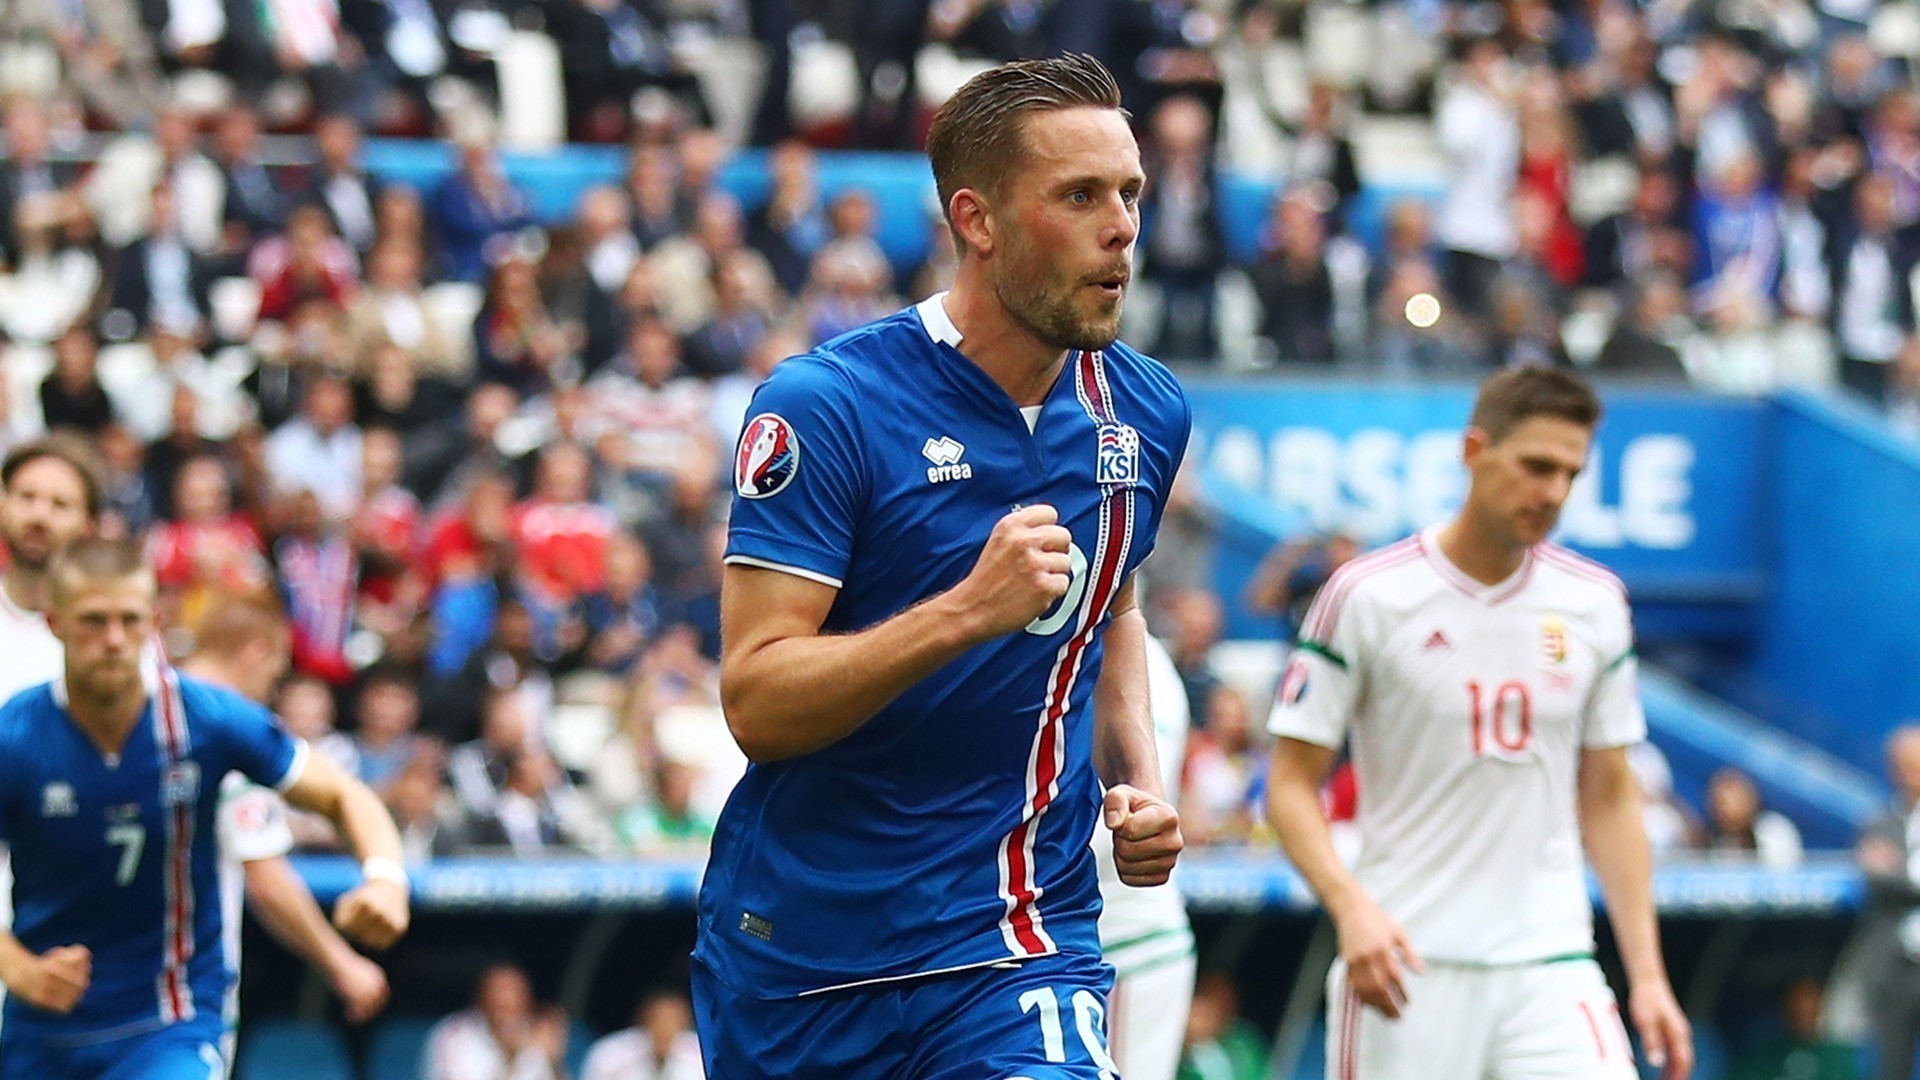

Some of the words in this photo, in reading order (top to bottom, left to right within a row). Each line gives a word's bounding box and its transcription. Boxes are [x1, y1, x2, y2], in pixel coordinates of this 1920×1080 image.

[927, 463, 972, 483] errea
[1465, 680, 1531, 755] 10
[104, 825, 146, 886] 7
